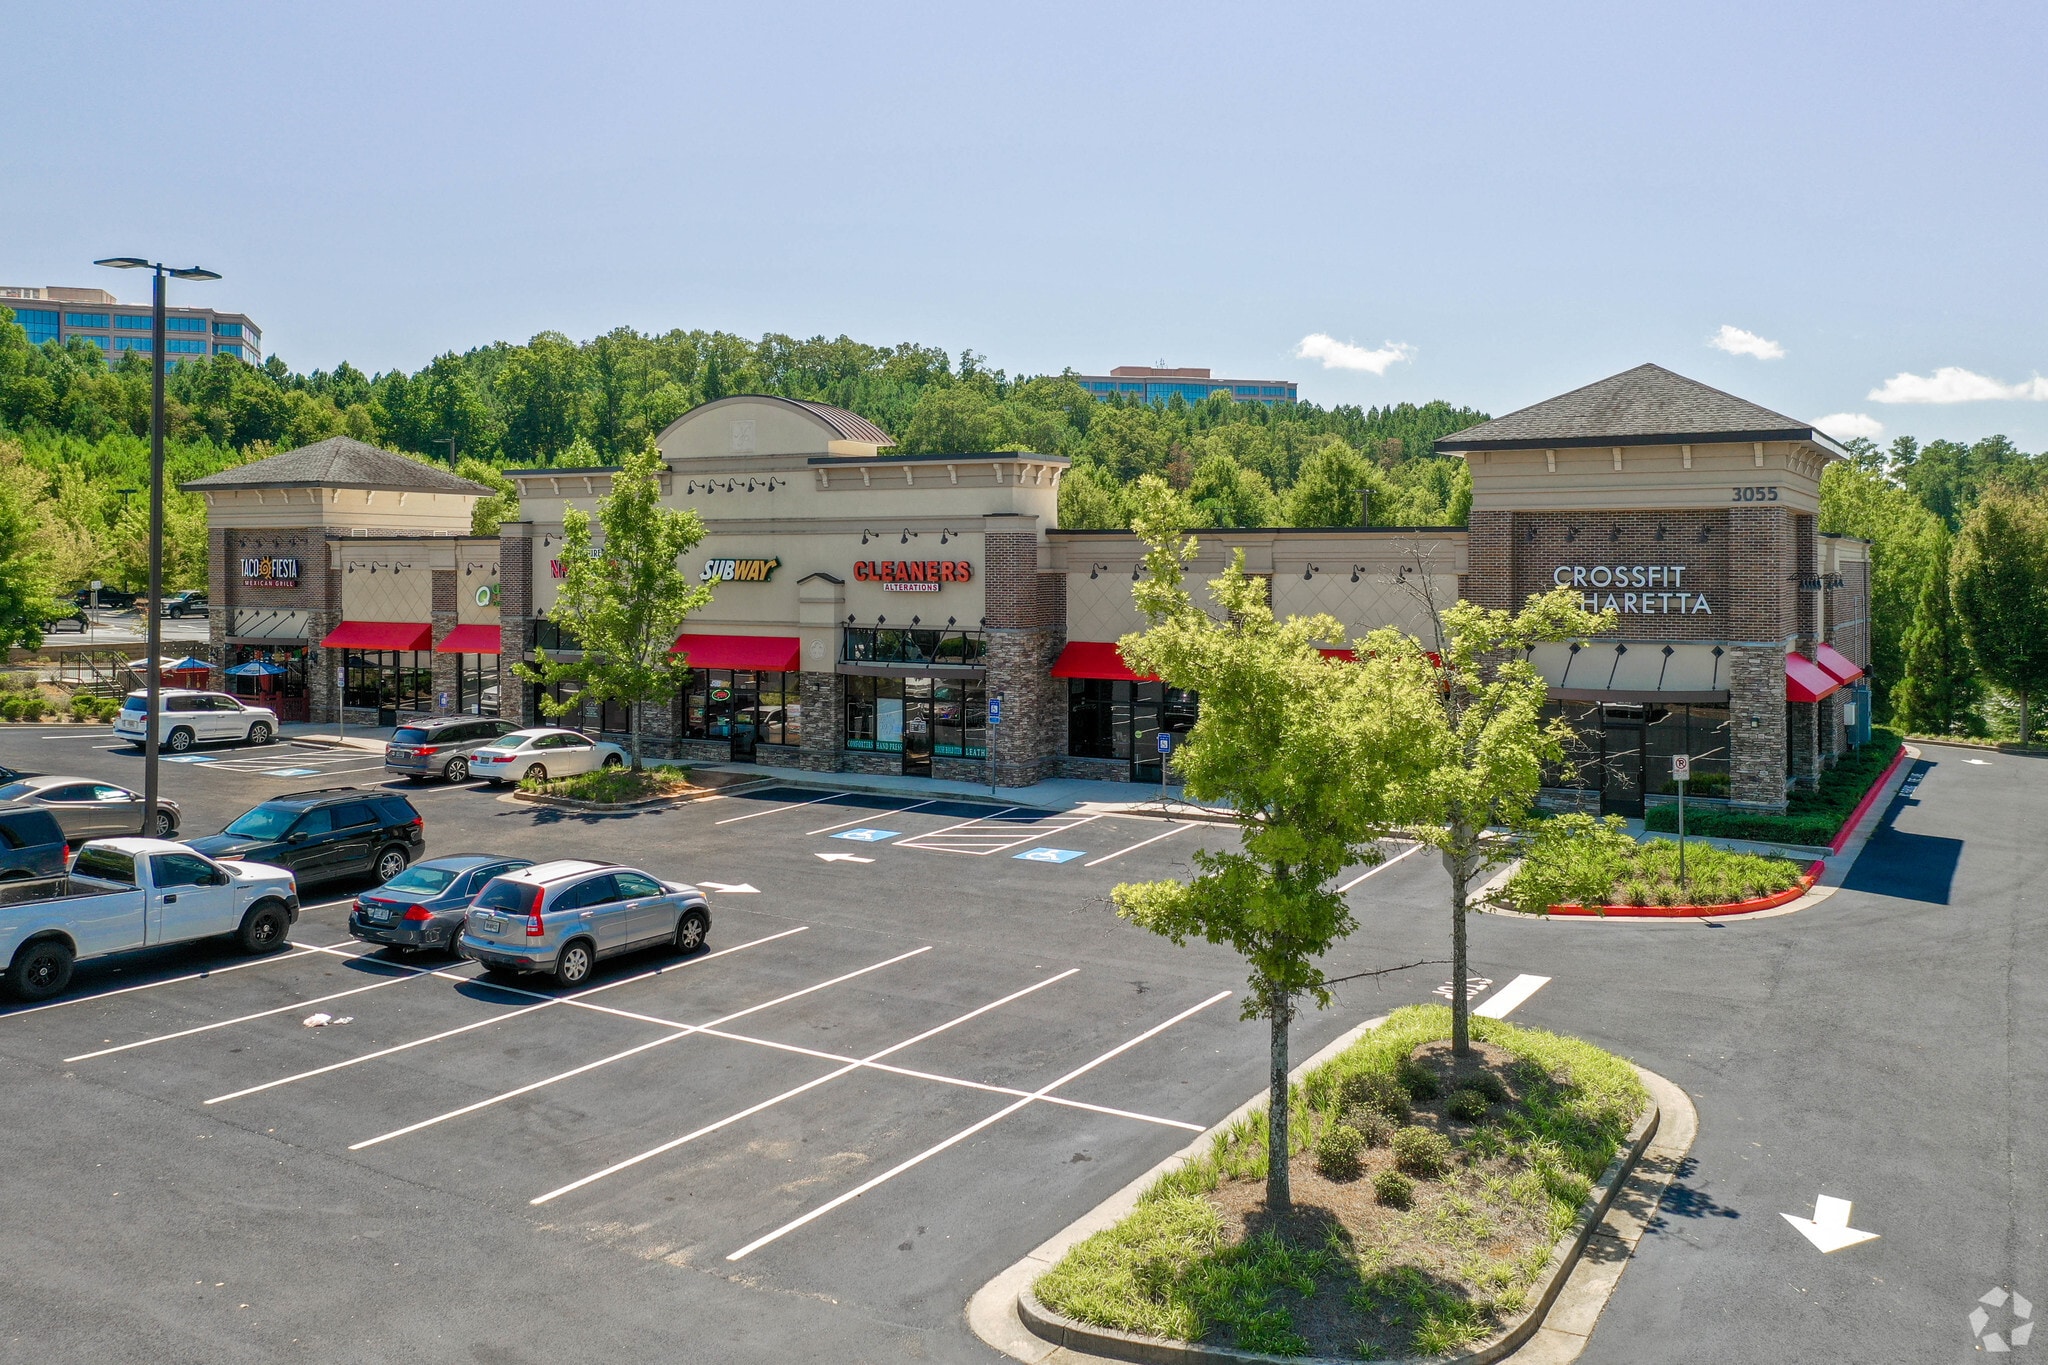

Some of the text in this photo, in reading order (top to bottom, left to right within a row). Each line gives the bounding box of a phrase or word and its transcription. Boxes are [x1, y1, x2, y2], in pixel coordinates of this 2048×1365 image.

[1732, 486, 1778, 502] 3055
[241, 558, 297, 578] TACO FIESTA
[699, 559, 778, 582] SUBWAY
[853, 560, 970, 583] CLEANERS
[1553, 565, 1686, 588] CROSSFIT
[884, 583, 938, 591] ALTERATIONS
[1580, 592, 1713, 615] HARETTA
